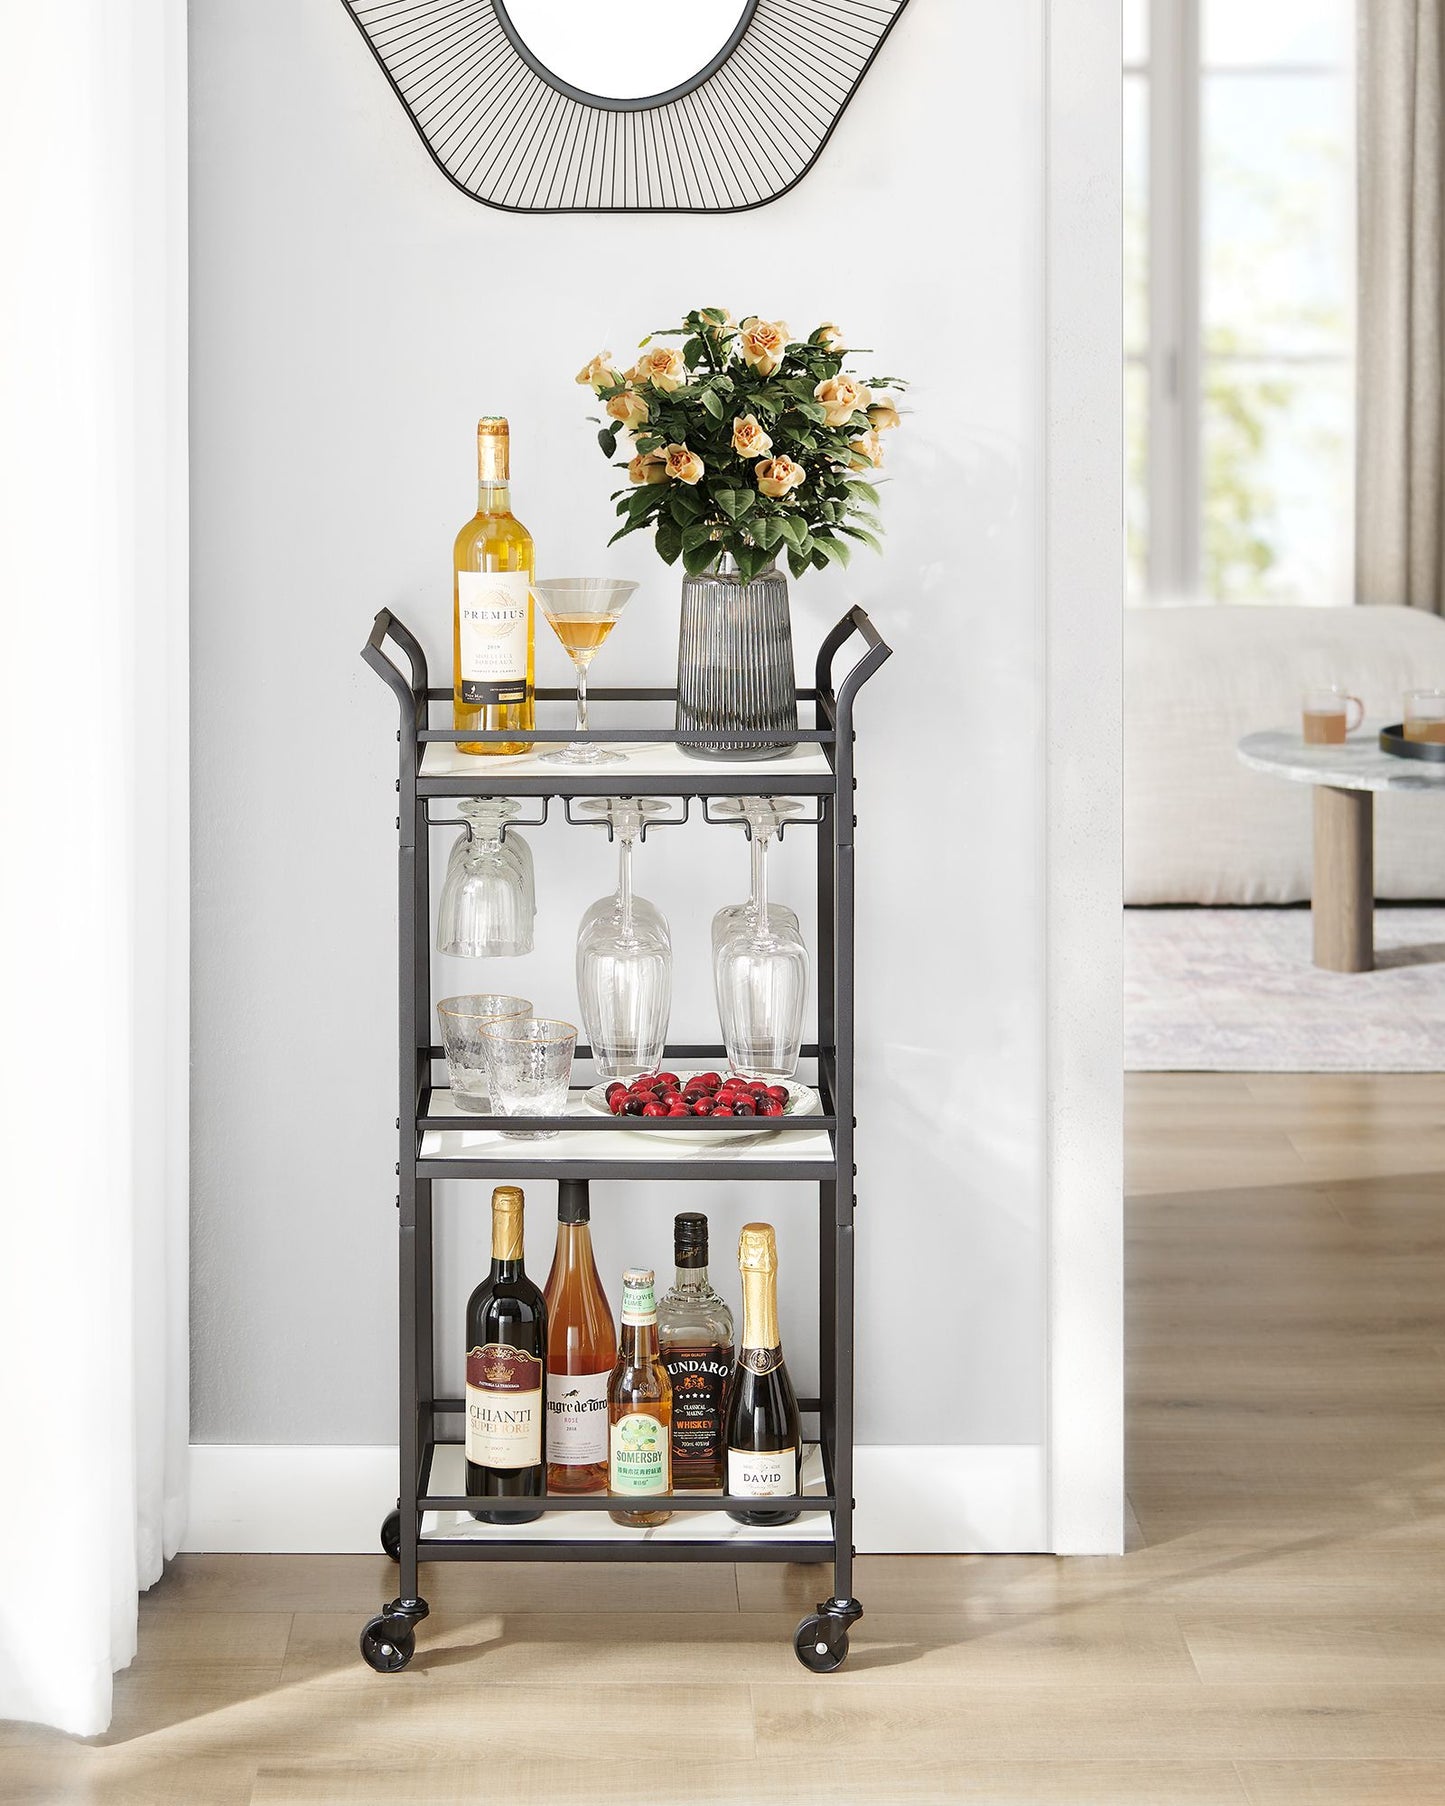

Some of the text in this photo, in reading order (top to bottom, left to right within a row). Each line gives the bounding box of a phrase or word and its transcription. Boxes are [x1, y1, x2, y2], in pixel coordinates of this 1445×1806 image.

[464, 609, 525, 620] PREMIUS
[667, 1360, 729, 1377] UNDARO
[574, 1400, 587, 1413] de
[469, 1404, 531, 1423] CHIANTI
[676, 1420, 713, 1430] WHISKEY
[616, 1450, 663, 1464] SOMERSBY
[743, 1473, 781, 1483] DAVID
